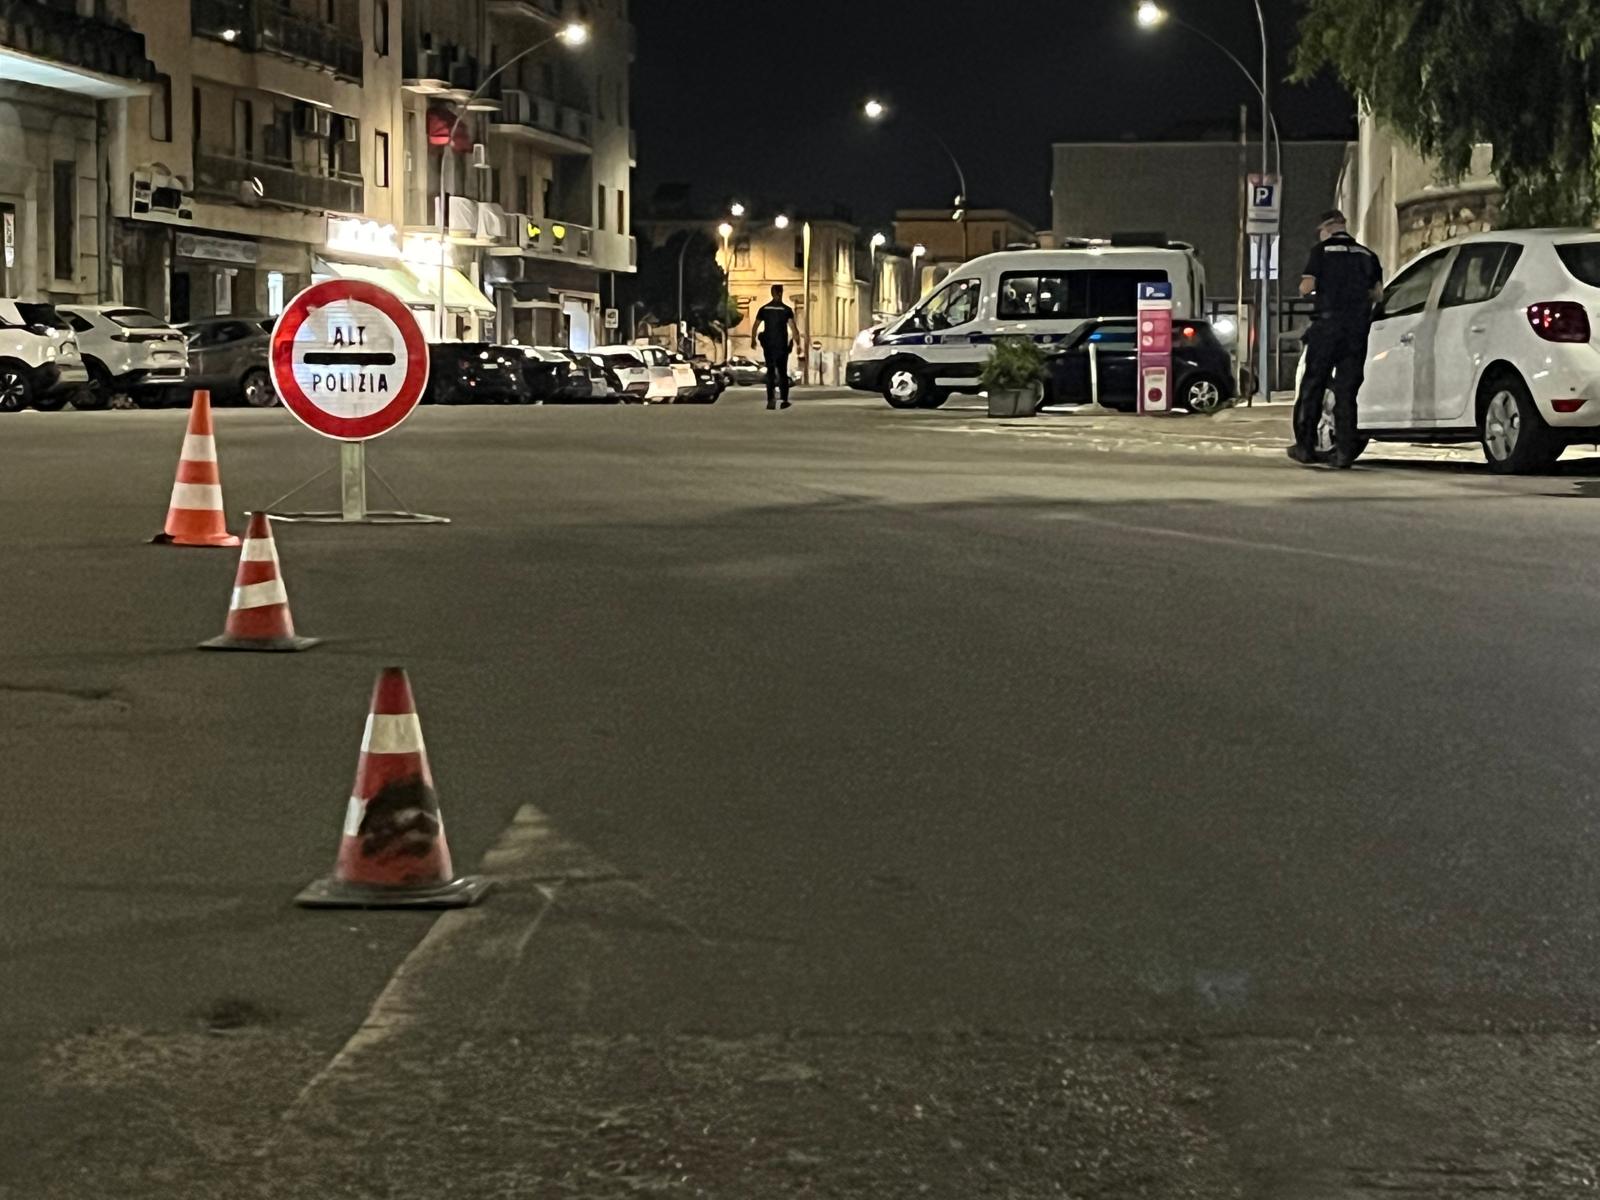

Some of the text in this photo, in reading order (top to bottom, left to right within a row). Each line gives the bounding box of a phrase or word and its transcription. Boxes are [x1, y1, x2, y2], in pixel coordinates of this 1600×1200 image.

[1255, 187, 1269, 204] P
[333, 326, 366, 346] ALT
[312, 373, 388, 393] POLIZIA
